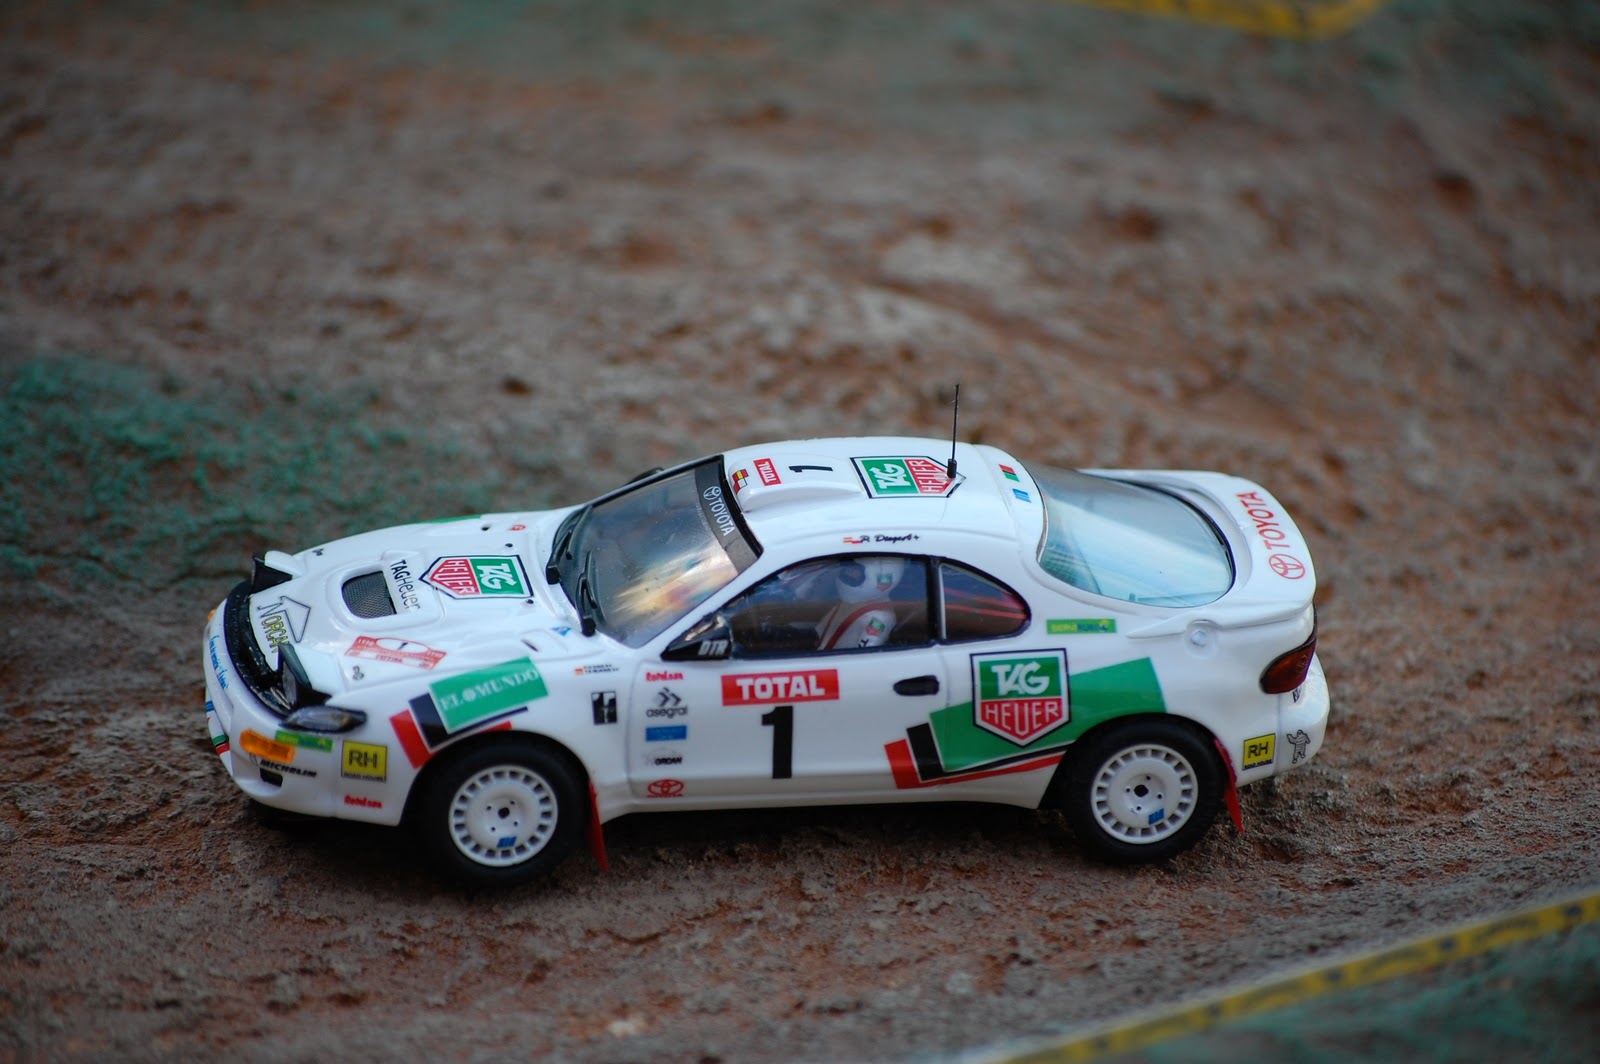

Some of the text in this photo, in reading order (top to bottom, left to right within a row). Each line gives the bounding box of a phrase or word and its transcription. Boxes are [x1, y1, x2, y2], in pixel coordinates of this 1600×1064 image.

[757, 460, 780, 484] TOTAL
[788, 465, 833, 473] 1
[870, 463, 912, 490] TAG
[908, 460, 947, 493] HEUER
[709, 497, 735, 537] TOYOTA
[1236, 492, 1290, 550] TOYOTA
[443, 558, 481, 596] HEUER
[476, 562, 518, 590] TAG
[475, 668, 540, 698] MUNDO
[735, 675, 826, 701] TOTAL
[991, 661, 1050, 697] TAG
[984, 700, 1060, 737] HEUER
[760, 706, 794, 780] 1
[1247, 742, 1269, 759] RH
[348, 749, 379, 769] RH
